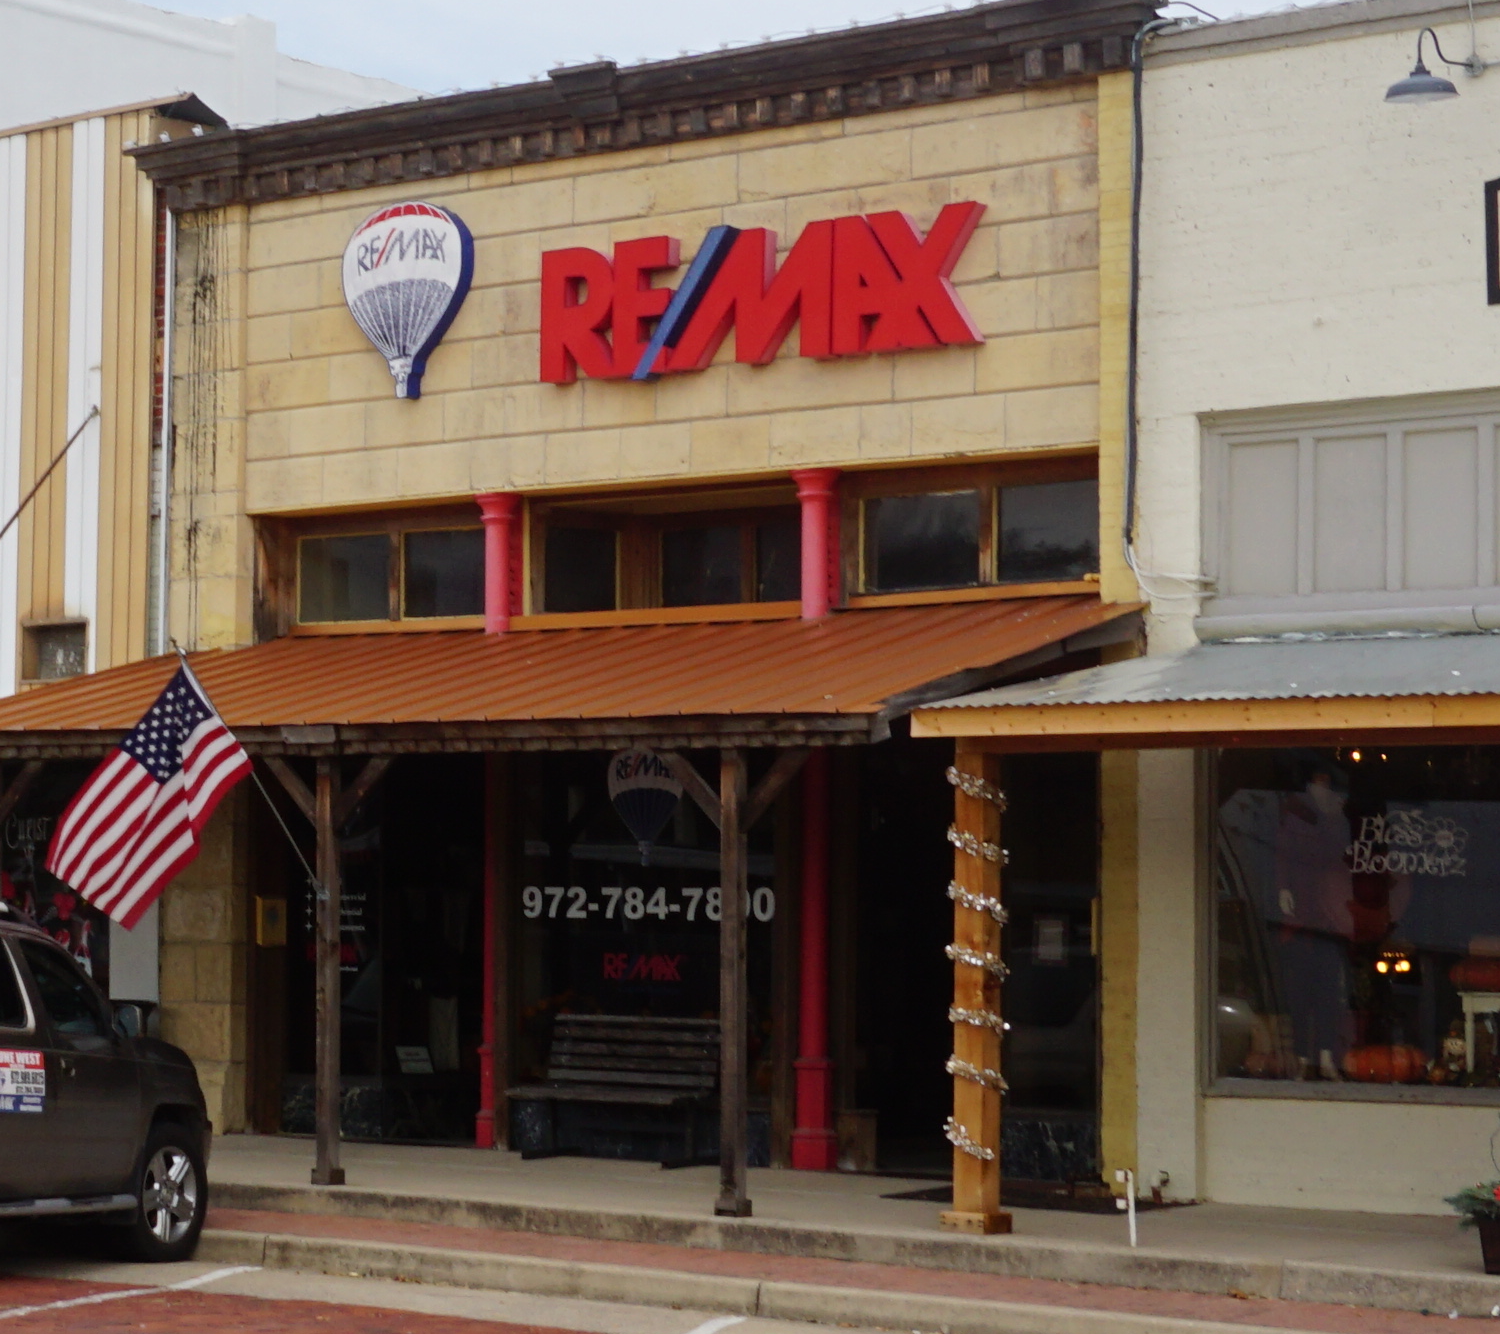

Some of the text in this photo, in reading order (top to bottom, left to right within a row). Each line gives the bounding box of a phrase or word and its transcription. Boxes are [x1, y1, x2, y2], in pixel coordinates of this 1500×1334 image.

[357, 227, 447, 277] RE/MAX
[540, 200, 987, 386] RE/MAX
[615, 753, 677, 783] RE/MA
[523, 886, 775, 922] 972-784-780
[15, 1052, 41, 1066] WEST
